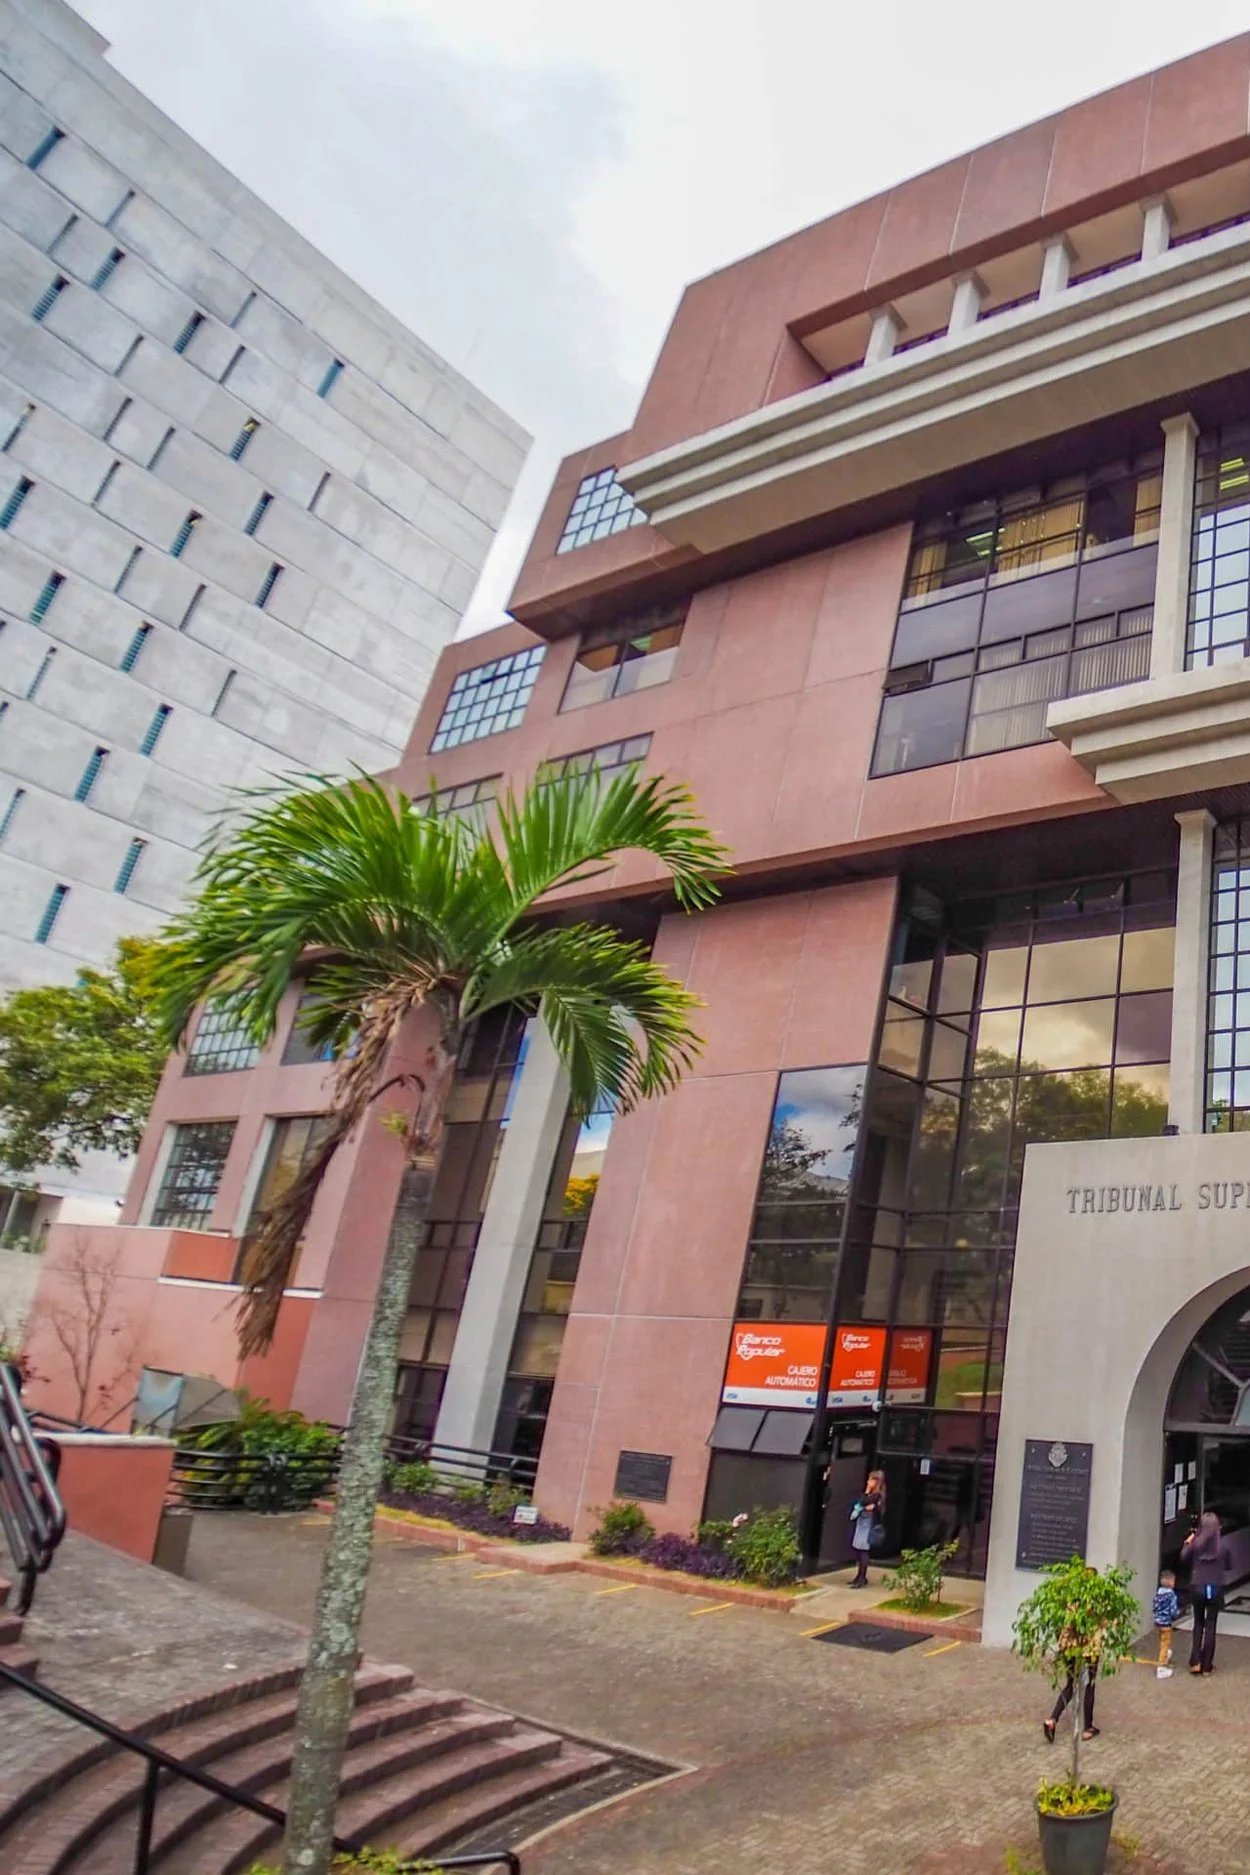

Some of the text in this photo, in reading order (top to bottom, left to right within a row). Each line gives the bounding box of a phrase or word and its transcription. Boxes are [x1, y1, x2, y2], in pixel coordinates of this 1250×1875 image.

[1067, 1184, 1183, 1214] TRIBUNAL
[740, 1333, 782, 1346] Banco
[736, 1345, 786, 1360] Popular
[787, 1365, 819, 1376] CAJERO
